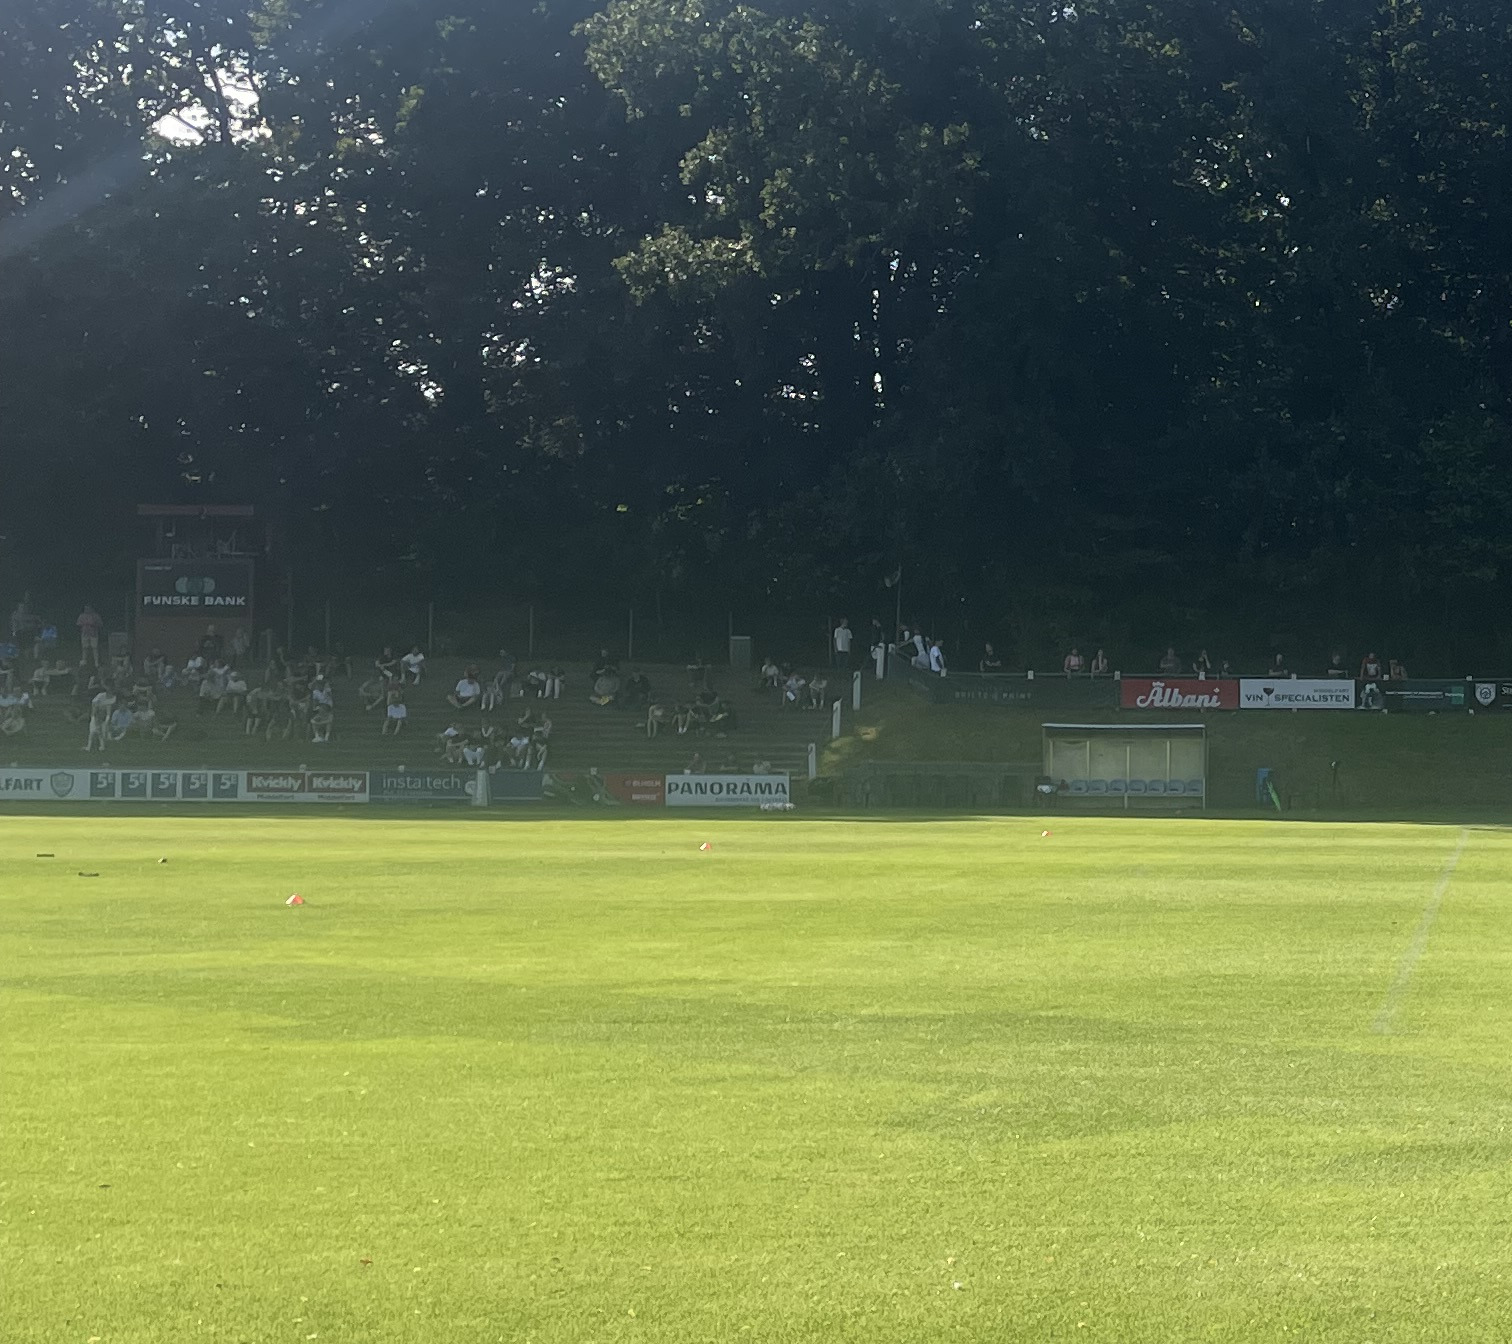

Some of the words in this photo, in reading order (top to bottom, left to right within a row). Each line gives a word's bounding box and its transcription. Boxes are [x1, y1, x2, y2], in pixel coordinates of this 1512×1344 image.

[204, 596, 246, 606] BANK
[1245, 694, 1264, 702] VIN
[1274, 694, 1351, 703] SPECIALISTEN
[252, 776, 302, 791] Kvickly
[312, 777, 362, 791] Kvickly
[667, 782, 787, 795] PANORAMA
